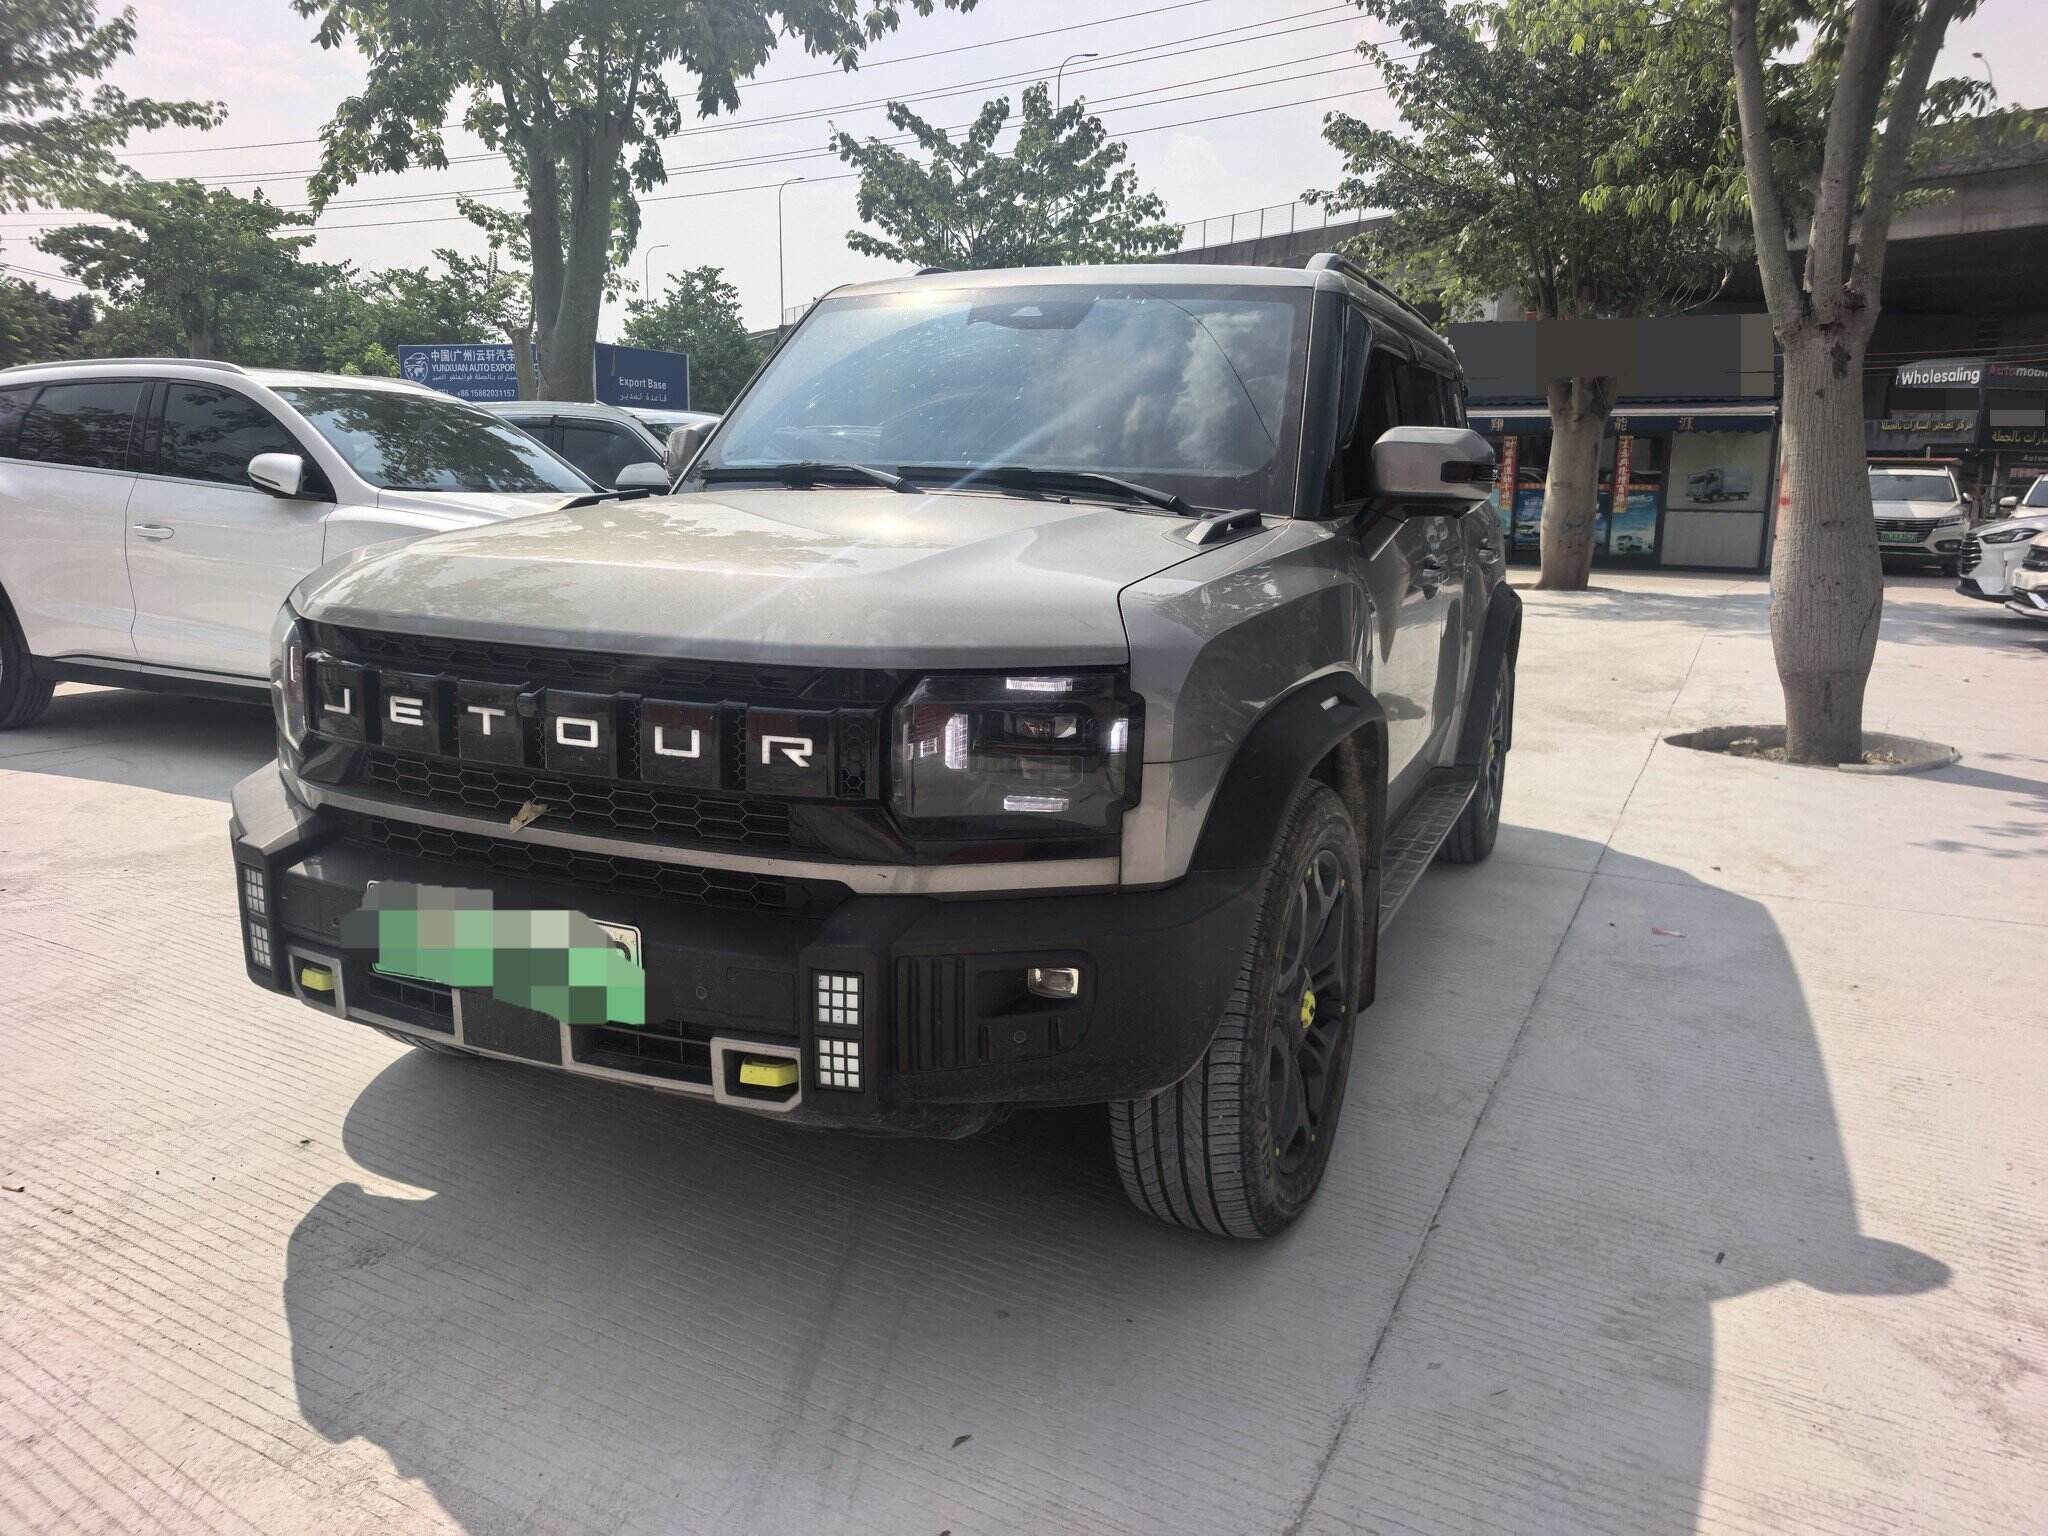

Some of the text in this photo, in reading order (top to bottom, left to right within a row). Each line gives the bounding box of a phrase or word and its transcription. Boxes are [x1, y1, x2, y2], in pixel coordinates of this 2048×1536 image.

[431, 363, 516, 372] YUNXUAN AUTO EXPOR
[618, 376, 667, 390] Export Base
[1901, 367, 1980, 385] Wholesaling
[323, 688, 813, 767] JETOUR
